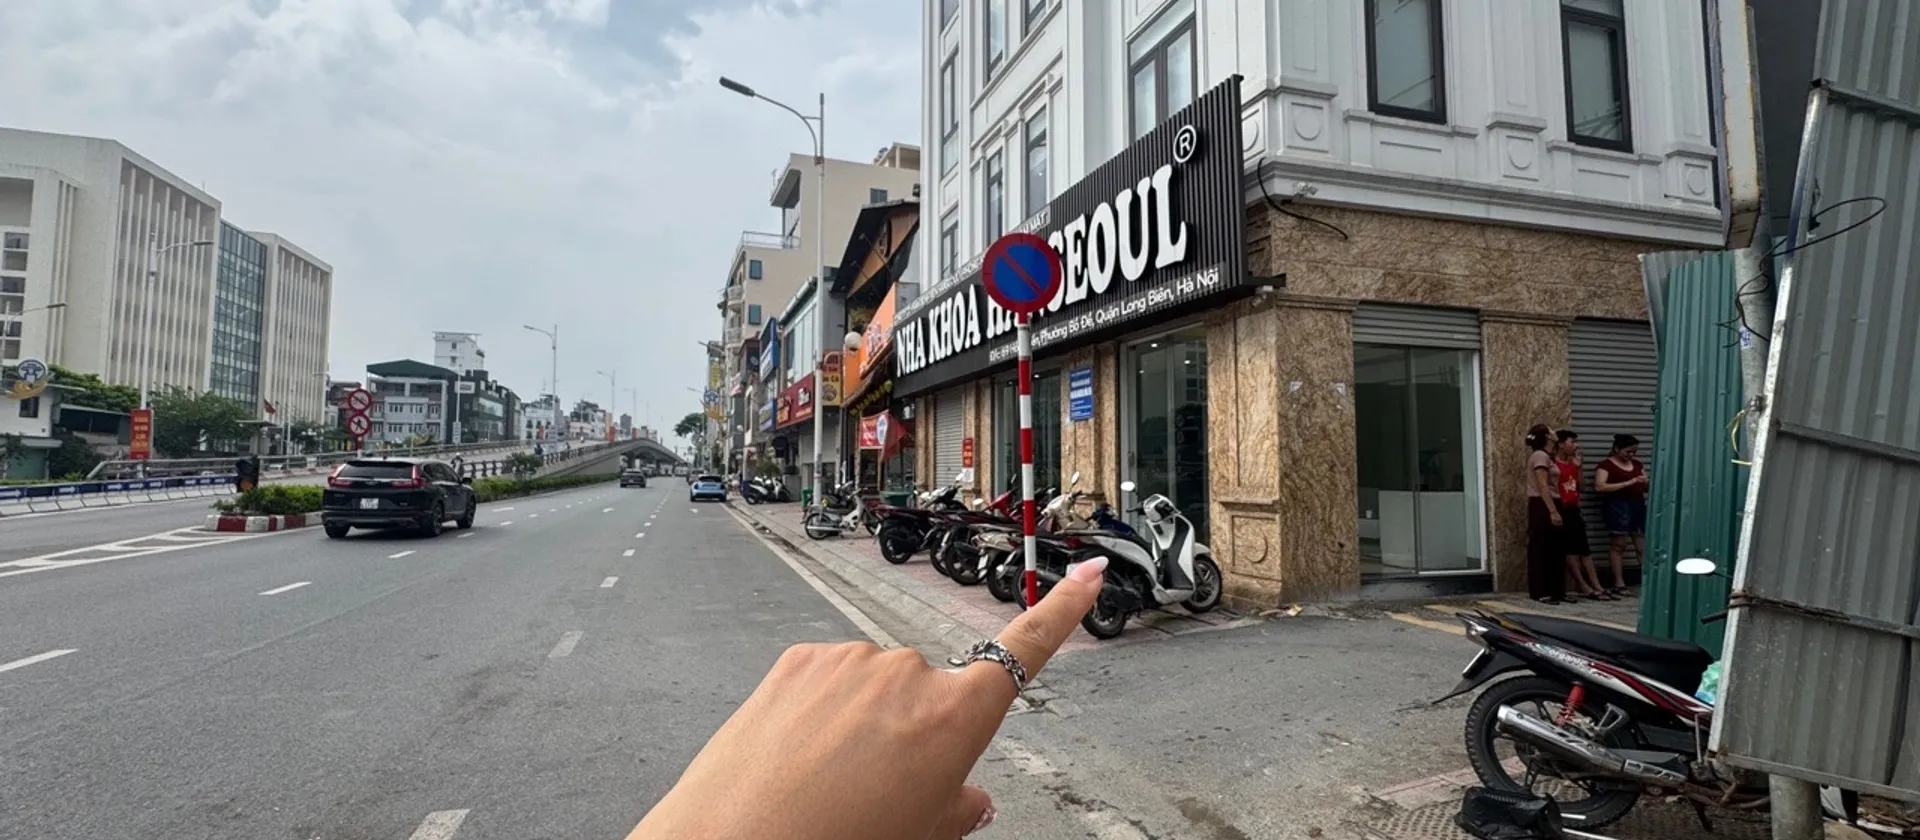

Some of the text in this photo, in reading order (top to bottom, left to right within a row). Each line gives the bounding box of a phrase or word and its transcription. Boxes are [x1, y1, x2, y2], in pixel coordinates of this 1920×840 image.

[1121, 298, 1146, 315] Long
[1176, 277, 1194, 296] Hà
[1196, 268, 1219, 290] Nội
[896, 316, 927, 378] NHA
[928, 283, 981, 364] KHOA
